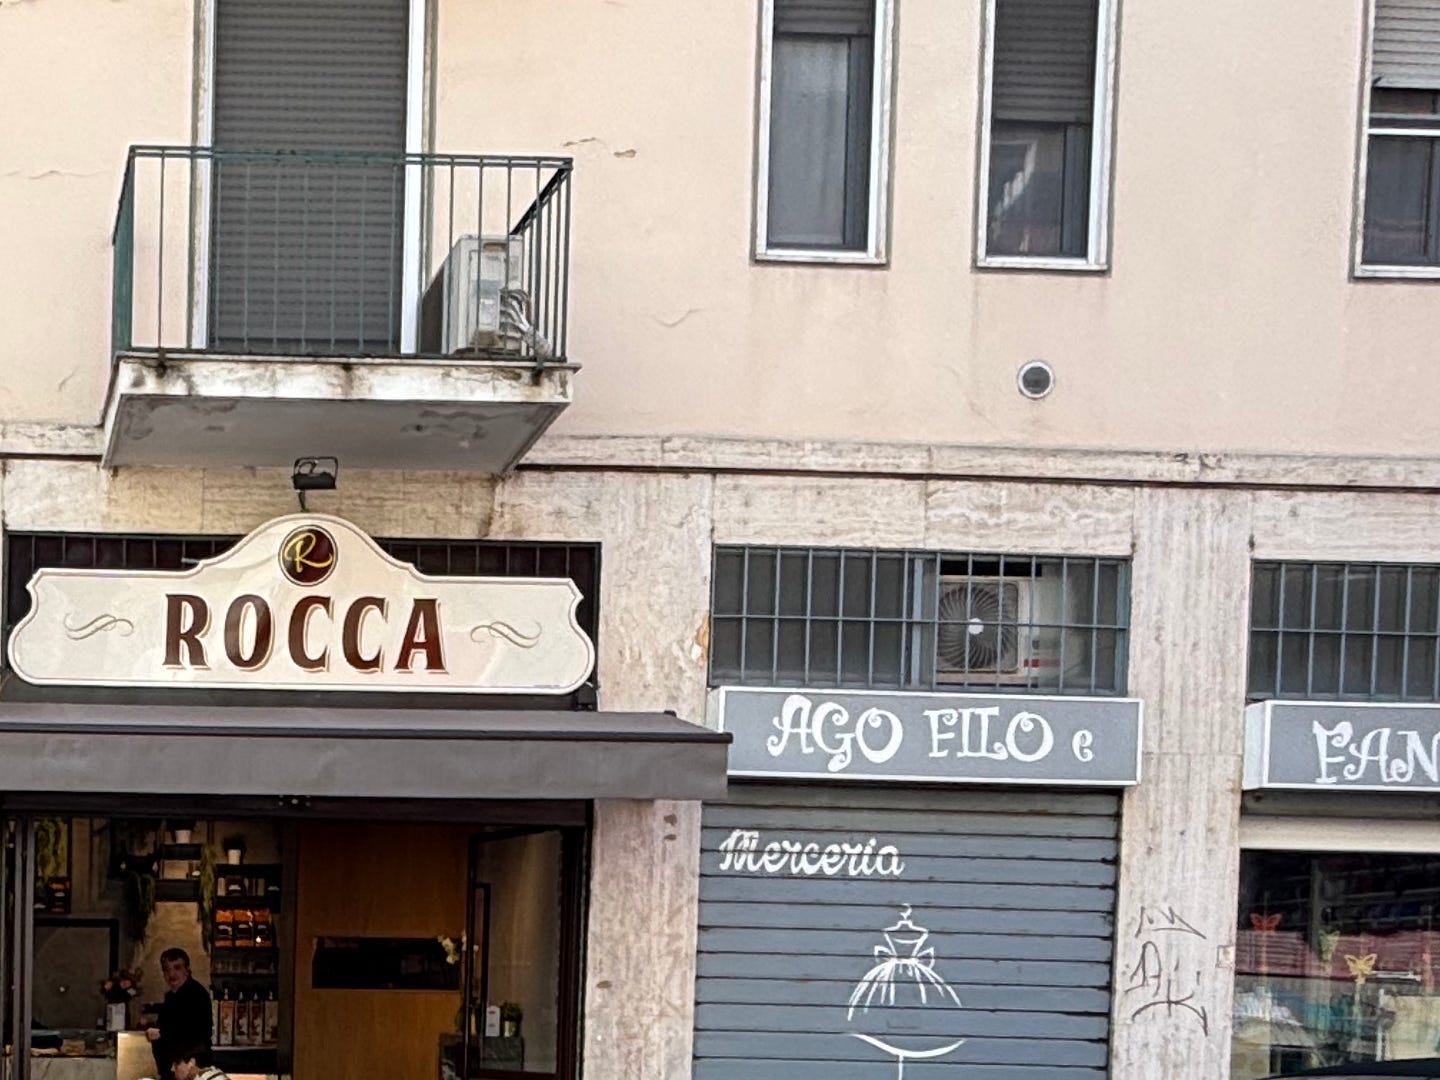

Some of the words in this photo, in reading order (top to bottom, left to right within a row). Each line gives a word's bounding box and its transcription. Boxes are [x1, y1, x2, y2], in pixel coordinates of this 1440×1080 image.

[284, 532, 333, 573] R
[163, 593, 448, 674] ROCCA
[767, 694, 903, 772] AGO
[922, 706, 1054, 763] FILO
[1312, 720, 1440, 784] FAN
[719, 828, 905, 876] Merceria
